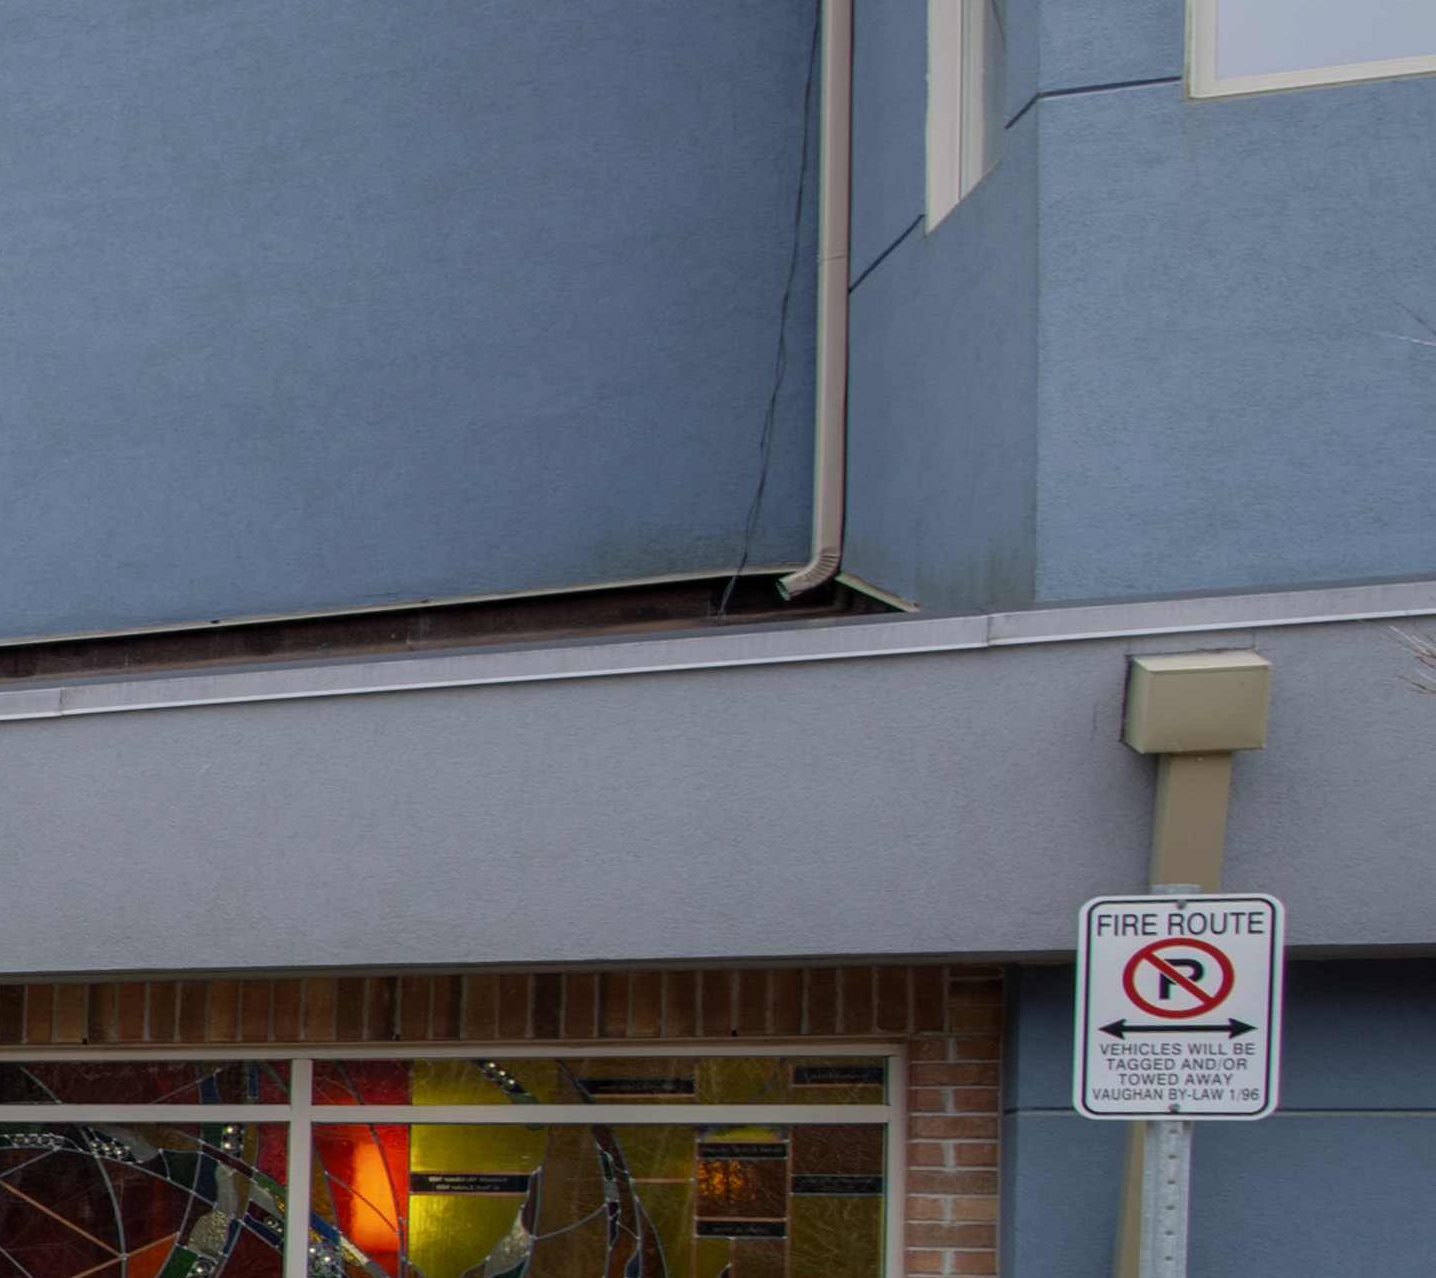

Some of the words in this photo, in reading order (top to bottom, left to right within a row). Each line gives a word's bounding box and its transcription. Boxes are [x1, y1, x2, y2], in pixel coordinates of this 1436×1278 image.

[1096, 914, 1158, 936] FIRE
[1167, 912, 1265, 935] ROUTE
[1099, 1043, 1182, 1056] VEHICLES
[1187, 1043, 1228, 1055] WILL
[1233, 1043, 1255, 1055] BE
[1106, 1058, 1175, 1071] TAGGED
[1181, 1058, 1247, 1070] AND/OR
[1118, 1073, 1179, 1086] TOWED
[1184, 1073, 1234, 1085] AWAY
[1092, 1088, 1163, 1101] VAUGHAN
[1168, 1088, 1224, 1101] BY-LAW
[1229, 1089, 1260, 1101] 1/96
